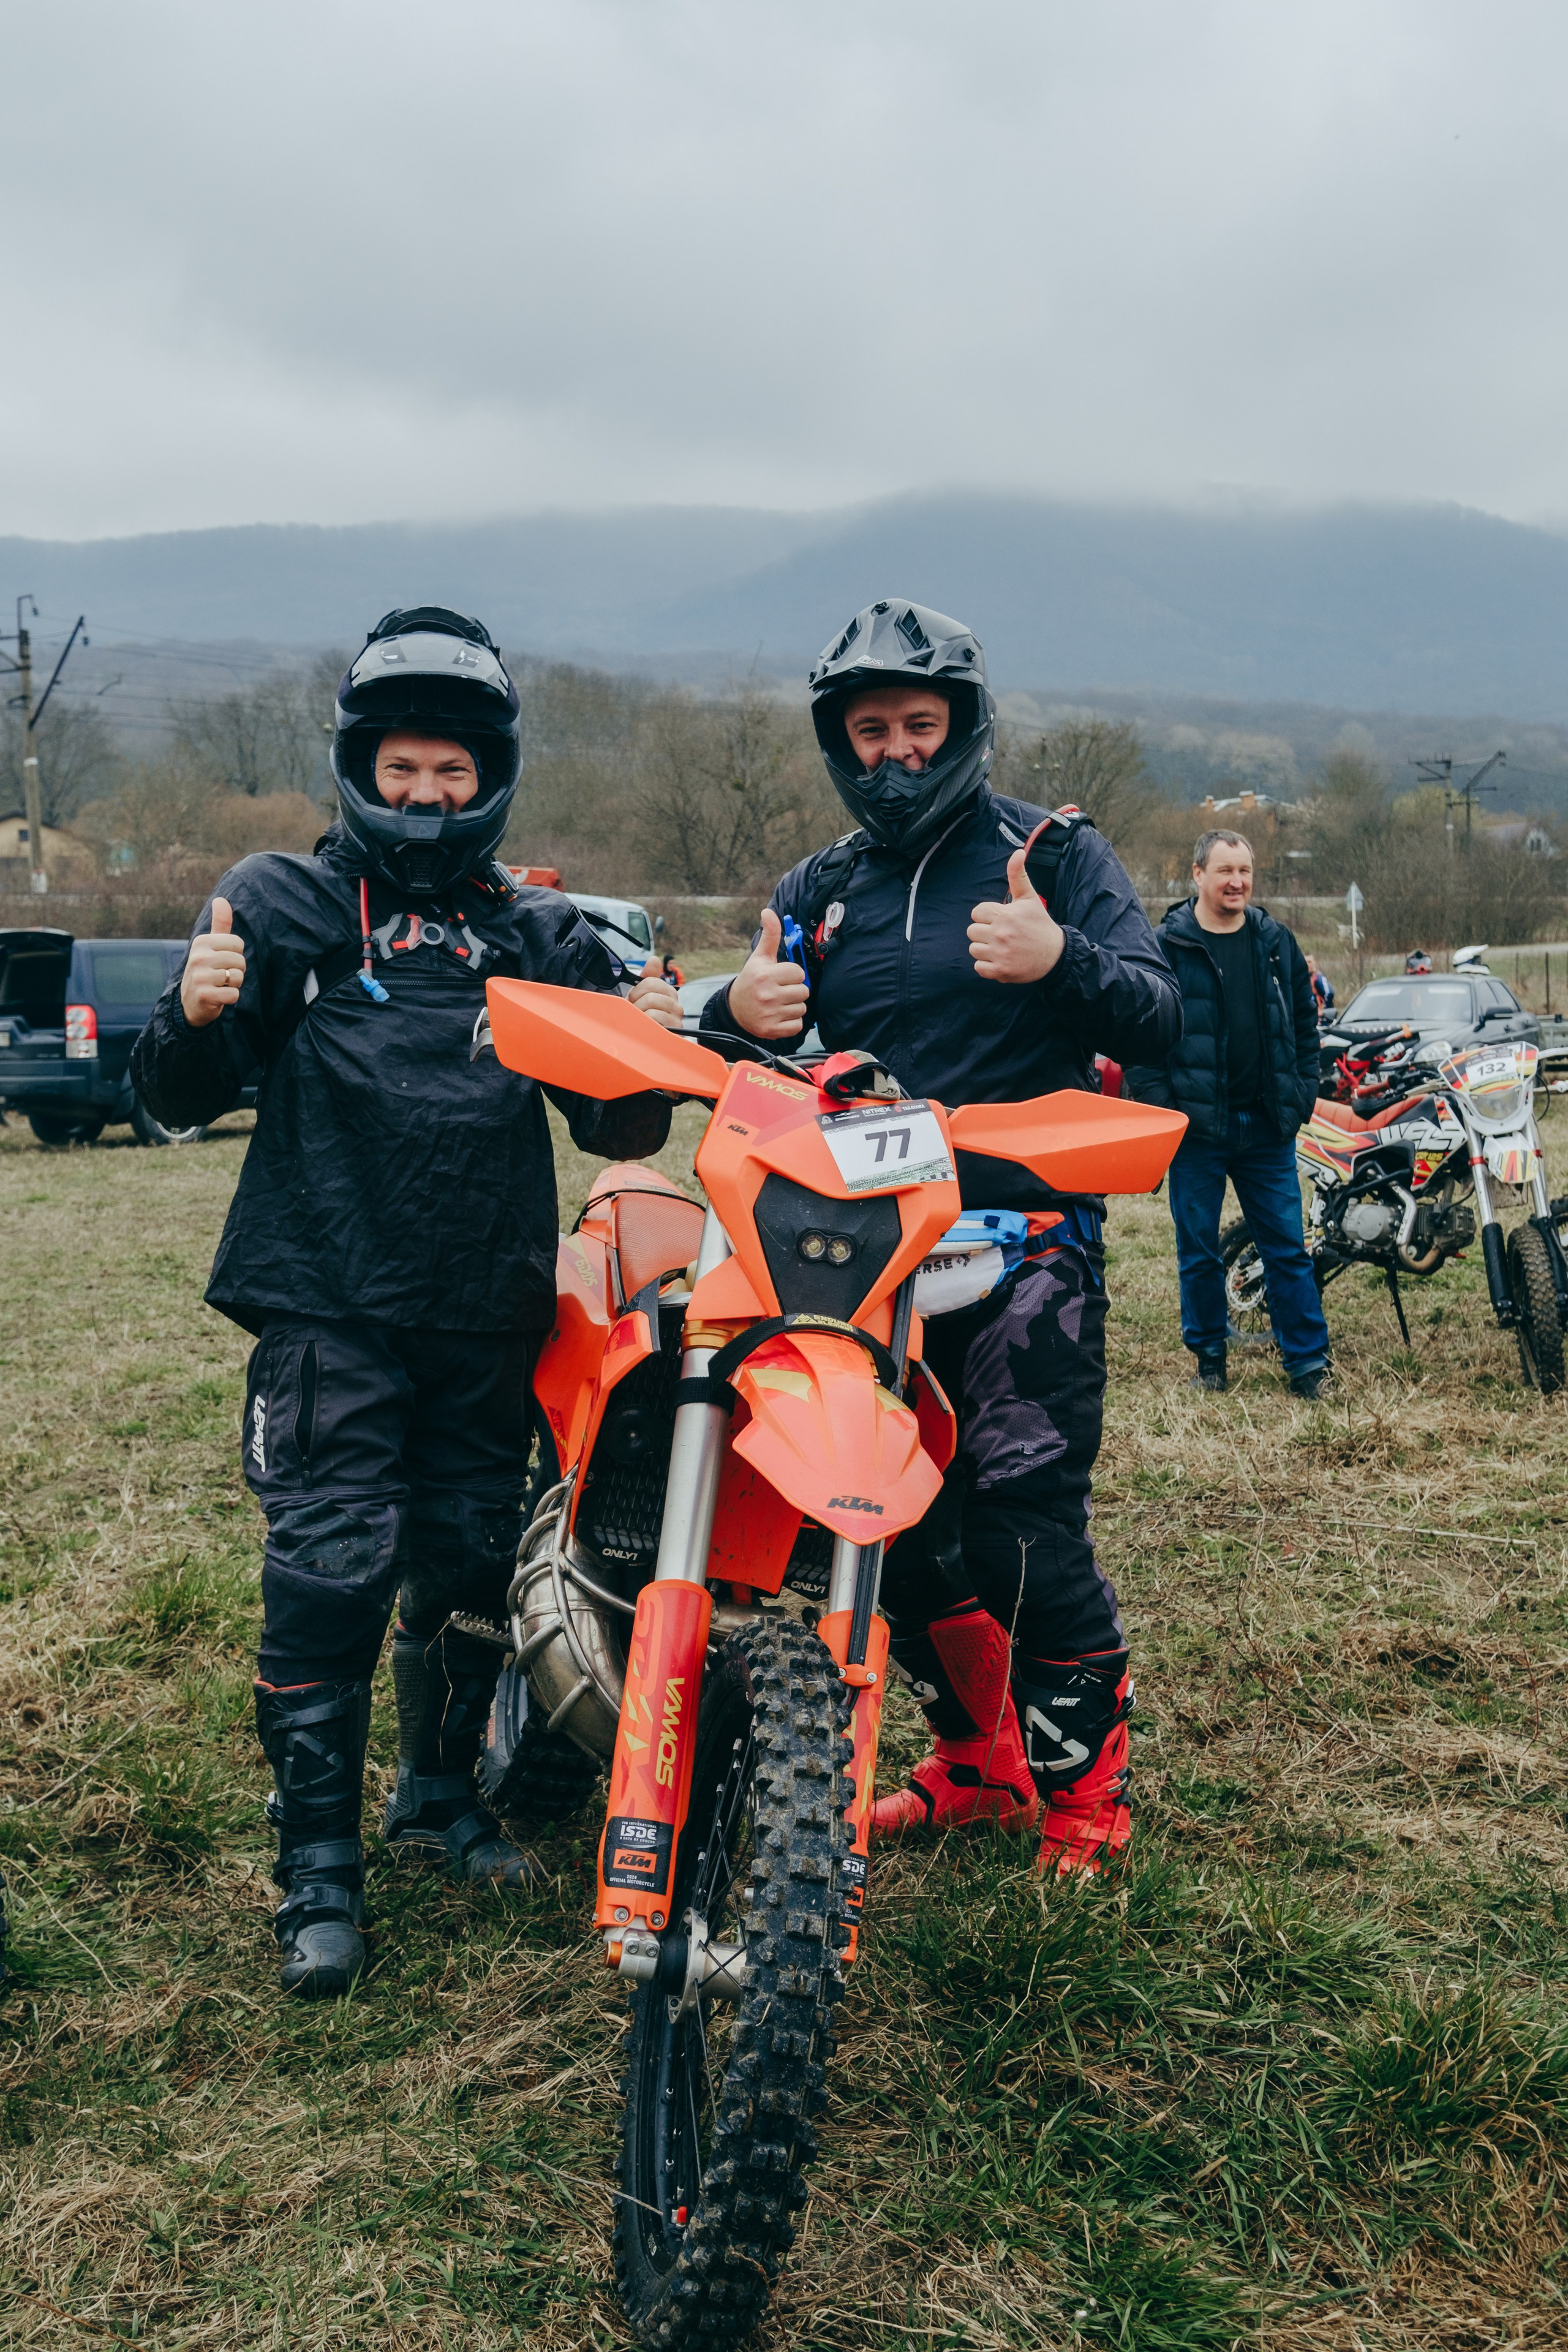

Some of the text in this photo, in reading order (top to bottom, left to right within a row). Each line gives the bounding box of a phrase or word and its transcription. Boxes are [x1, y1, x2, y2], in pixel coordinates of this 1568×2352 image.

[1477, 1062, 1506, 1076] 132
[747, 1072, 809, 1101] VAMOS
[862, 1106, 891, 1115] NITREX
[727, 1125, 748, 1136] KTM
[864, 1128, 911, 1163] 77
[813, 1315, 853, 1329] ENDURO
[252, 1395, 266, 1473] LEATT
[827, 1495, 884, 1515] KTM
[602, 1548, 638, 1561] ONLY1
[791, 1580, 826, 1594] ONLY1
[1051, 1697, 1081, 1706] LEATT
[655, 1678, 685, 1790] VAMOS
[620, 1825, 657, 1841] ISDE
[618, 1853, 652, 1868] KTM
[627, 1879, 655, 1887] MOTORCYCLE
